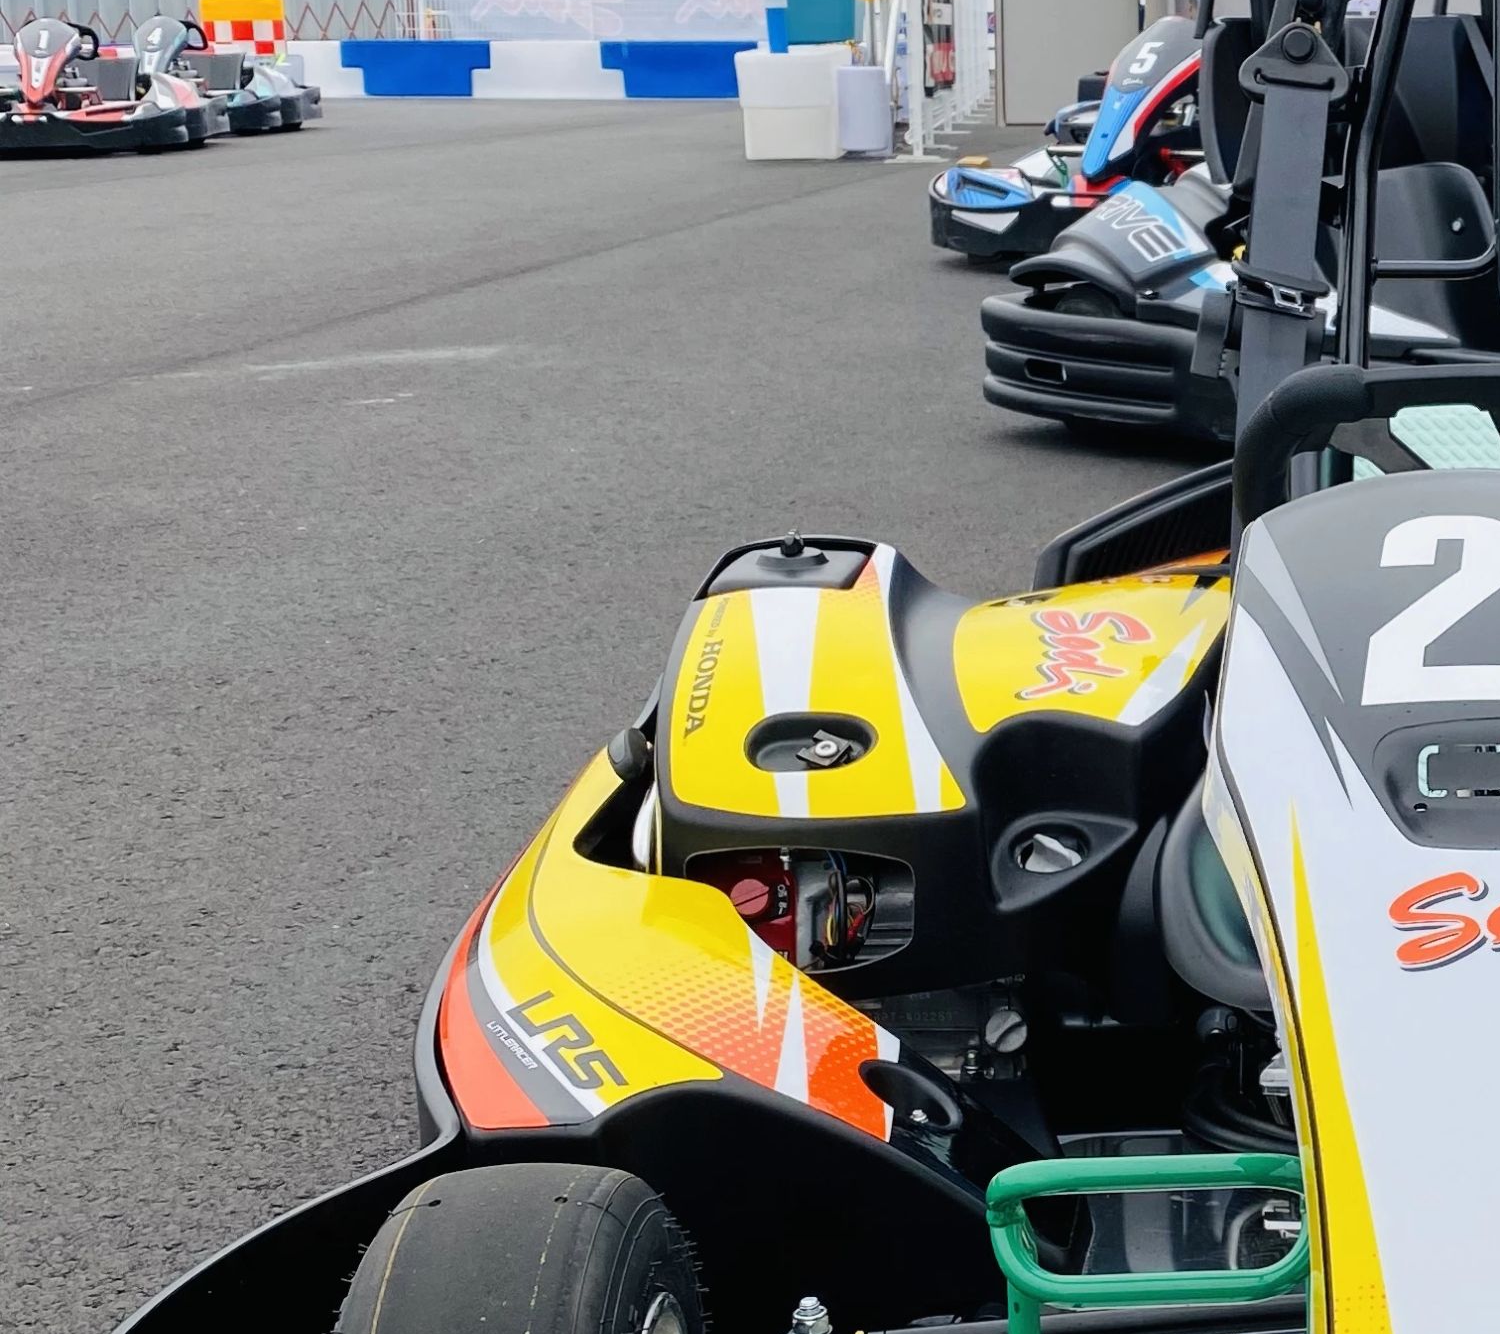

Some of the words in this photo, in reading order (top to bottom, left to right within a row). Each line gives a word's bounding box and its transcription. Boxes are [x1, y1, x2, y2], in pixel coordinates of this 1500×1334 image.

[38, 29, 49, 50] 1
[1129, 41, 1164, 74] 5
[1015, 610, 1155, 699] Sodi
[684, 639, 724, 739] HONDA
